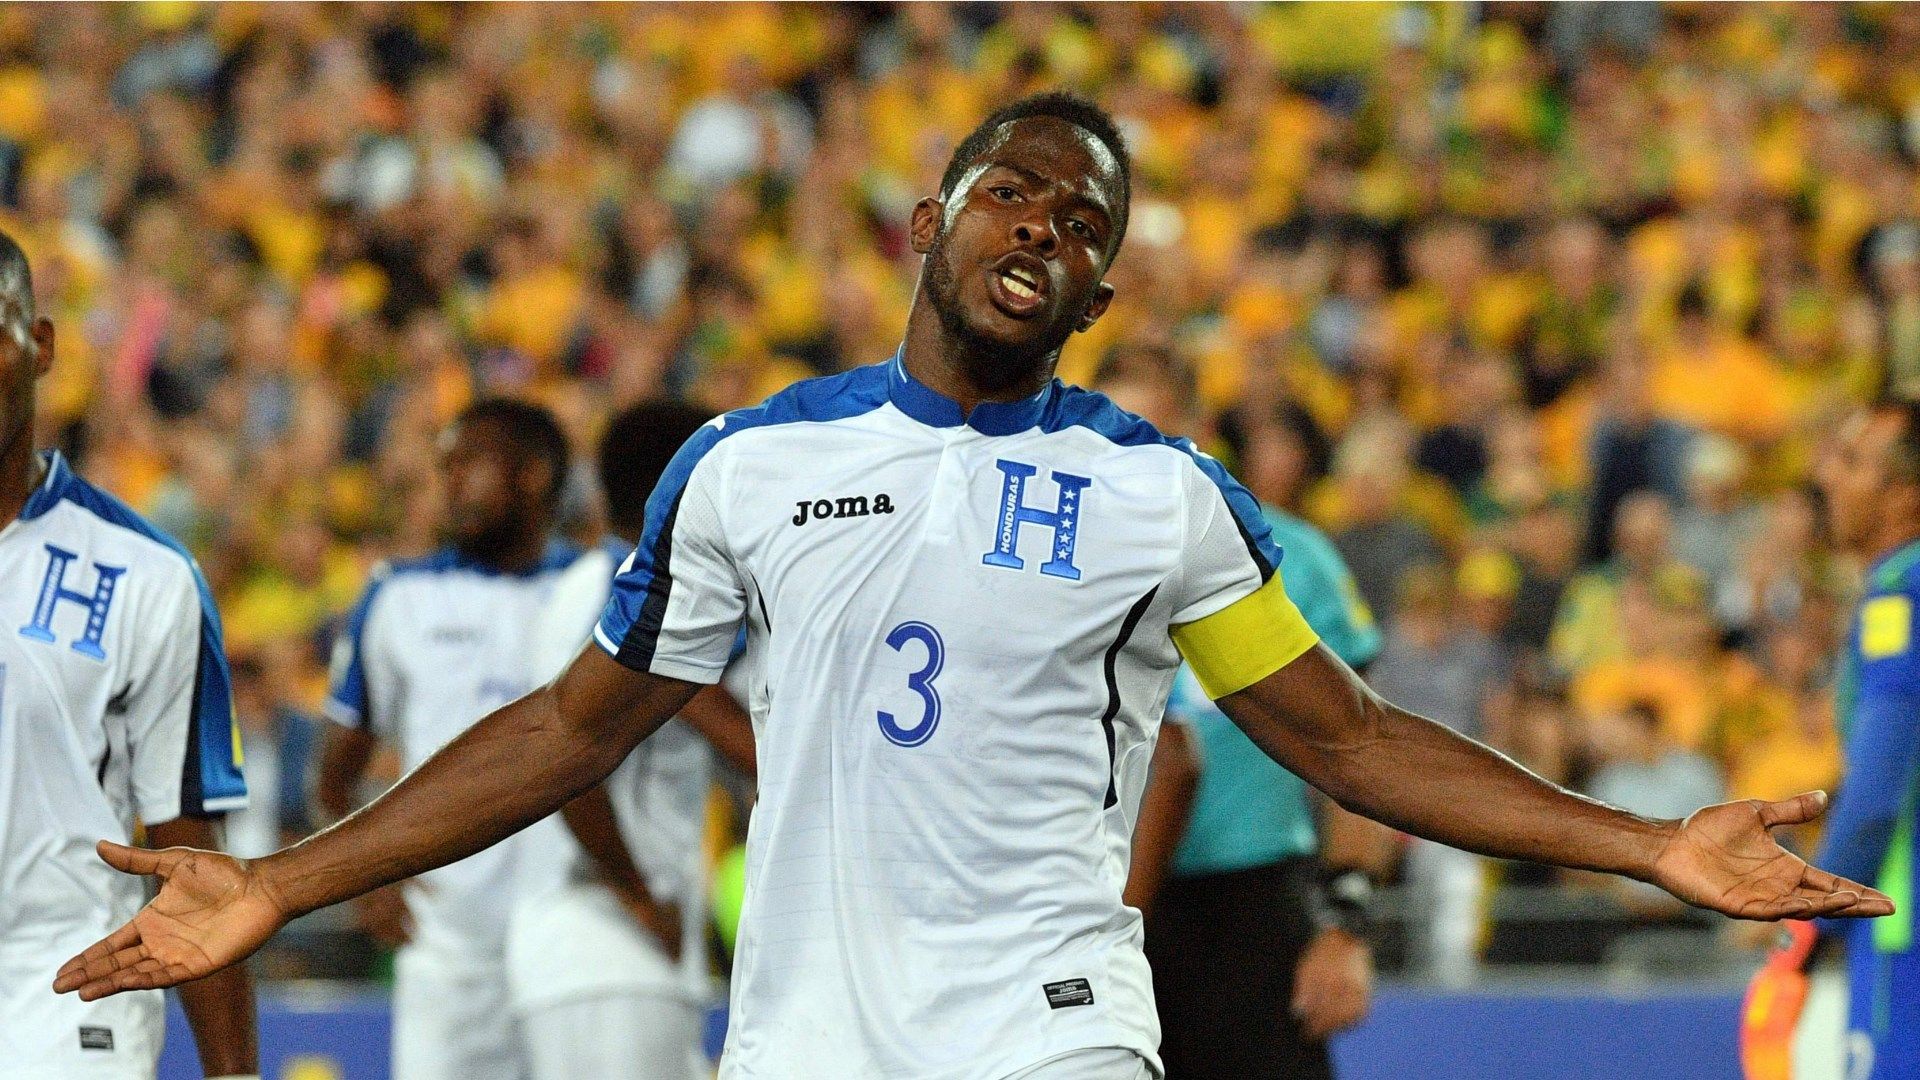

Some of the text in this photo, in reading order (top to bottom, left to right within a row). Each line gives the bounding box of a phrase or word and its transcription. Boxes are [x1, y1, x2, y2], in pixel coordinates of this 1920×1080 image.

[982, 458, 1092, 581] H
[1001, 475, 1020, 553] HONDURAS
[19, 543, 127, 660] H
[877, 620, 945, 748] 3
